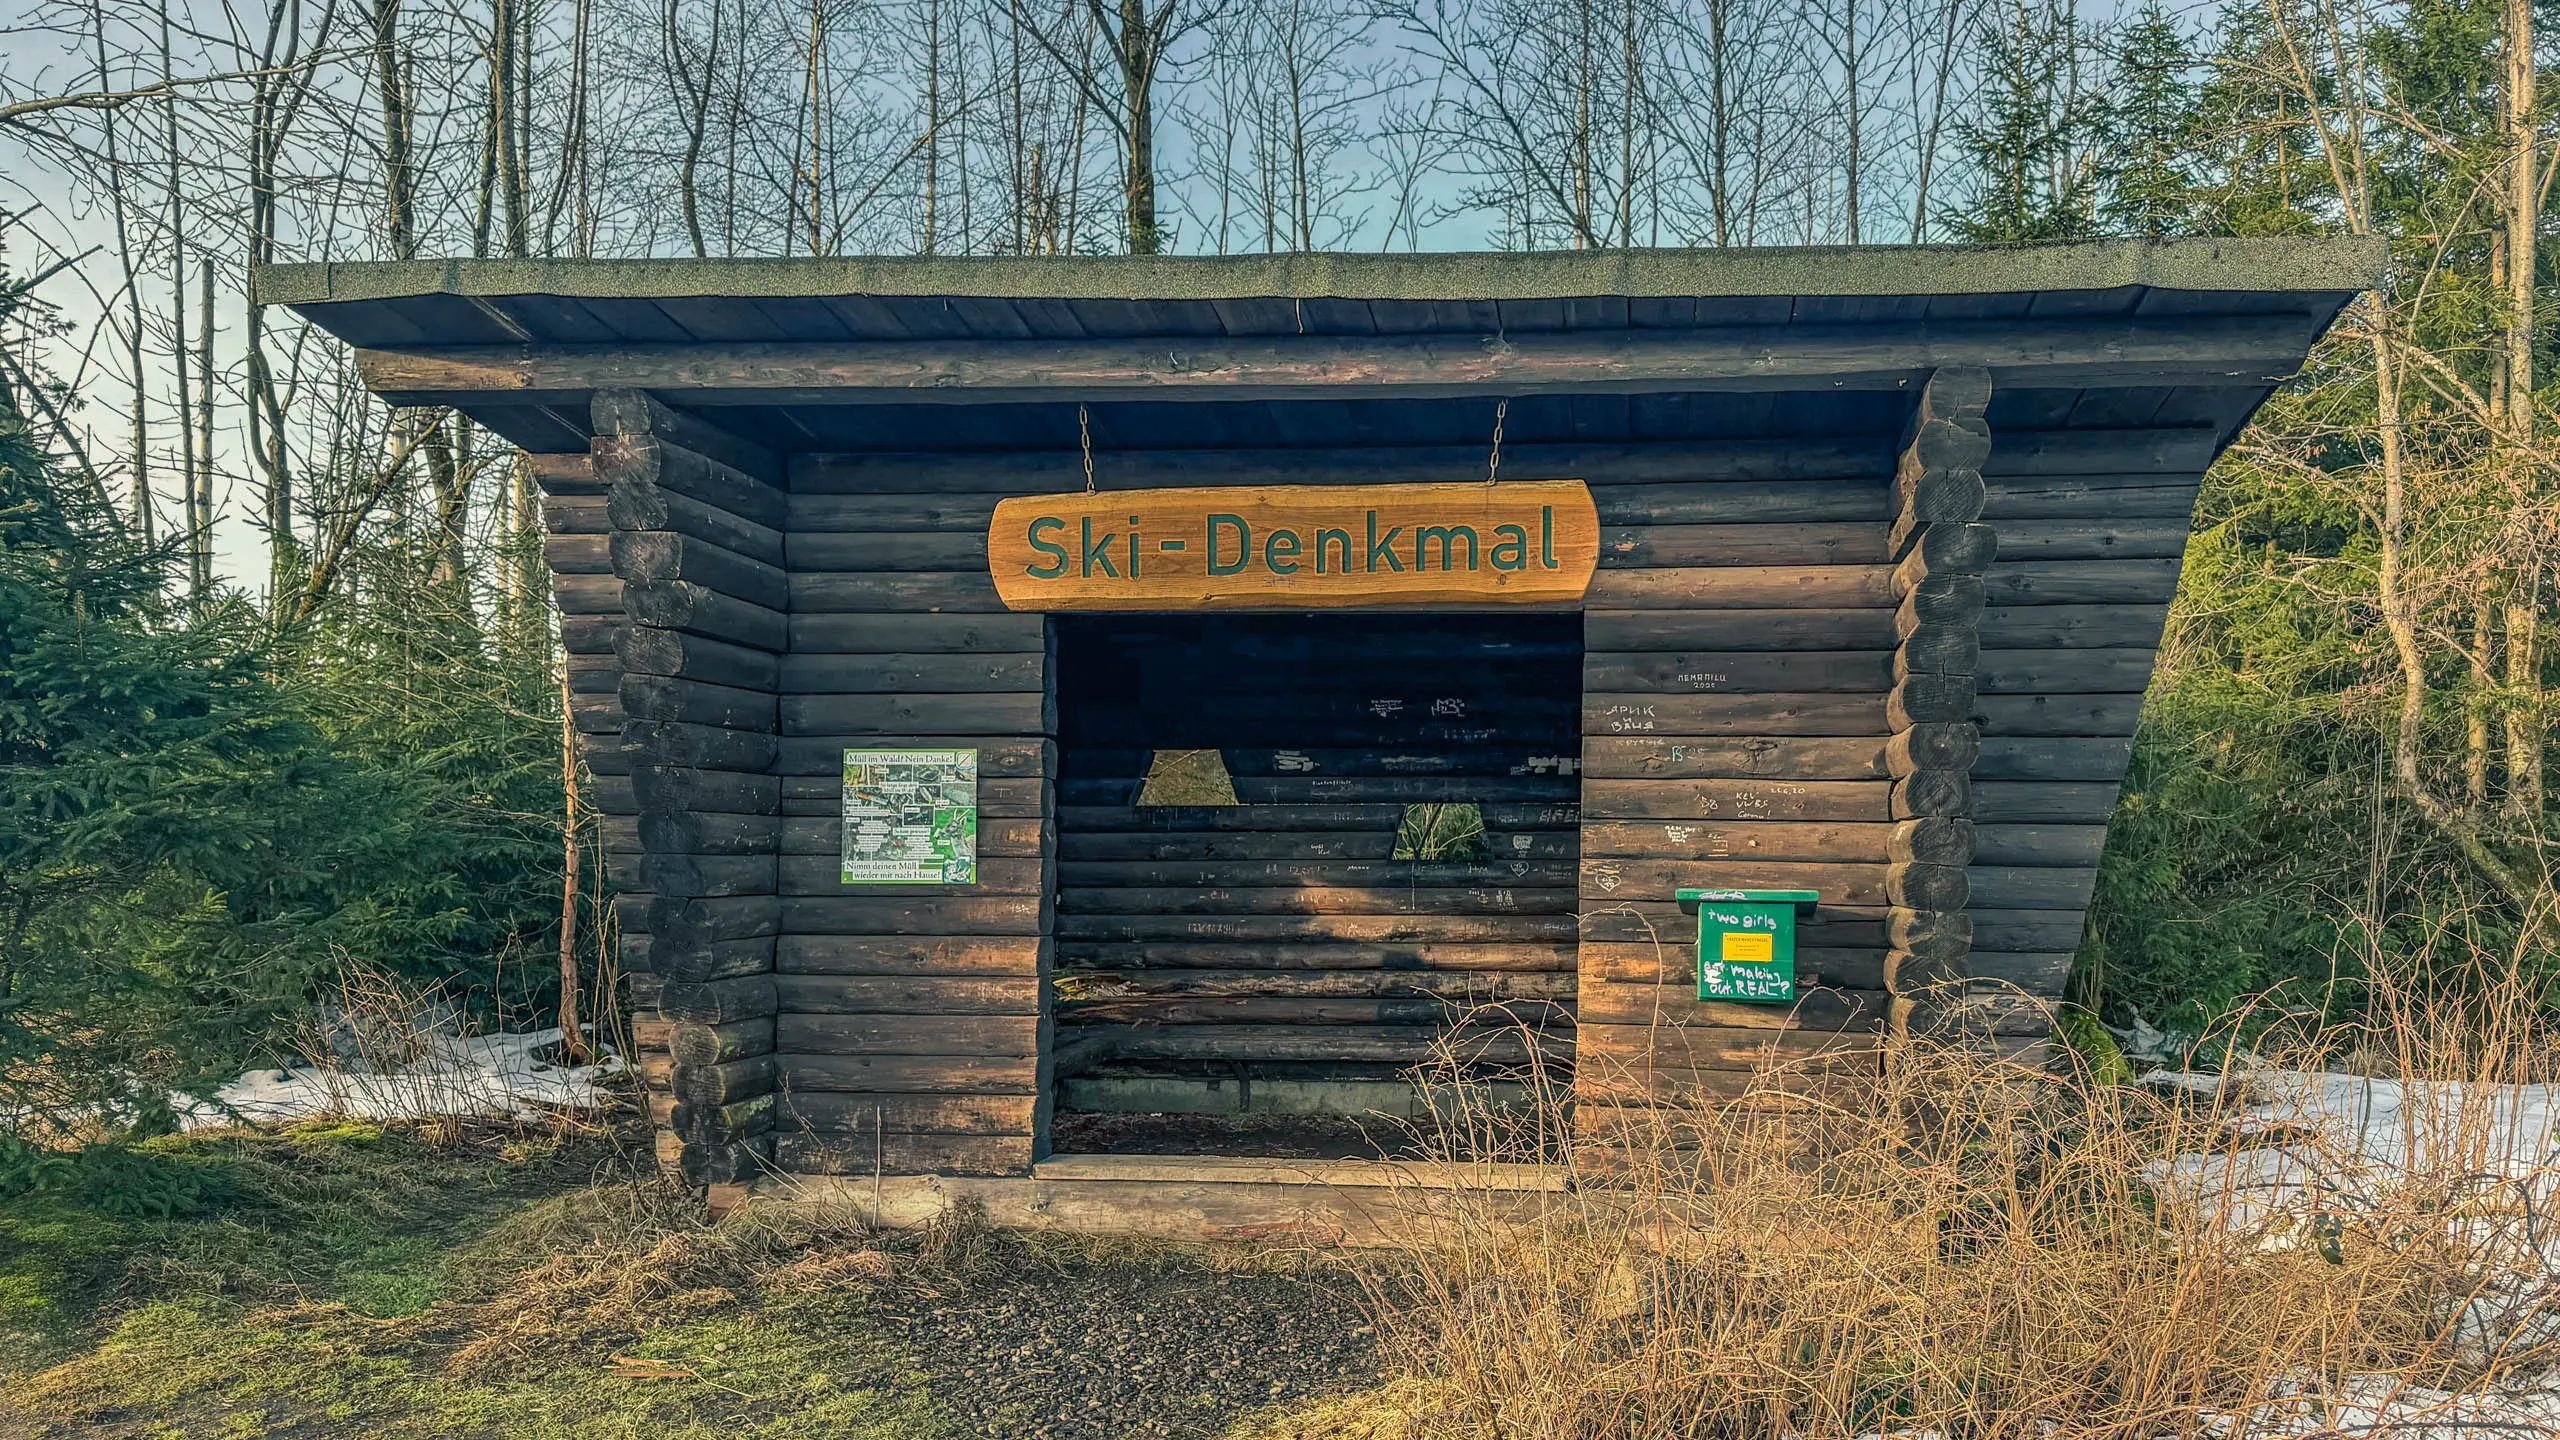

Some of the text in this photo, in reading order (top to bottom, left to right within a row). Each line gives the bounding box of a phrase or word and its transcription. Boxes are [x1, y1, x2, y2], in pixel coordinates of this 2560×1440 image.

[905, 754, 924, 762] Nein
[846, 861, 917, 870] Nimm deinen Müll
[854, 871, 941, 879] wieder mit nach Hause!
[1708, 909, 1777, 930] two girls
[1730, 965, 1781, 986] making
